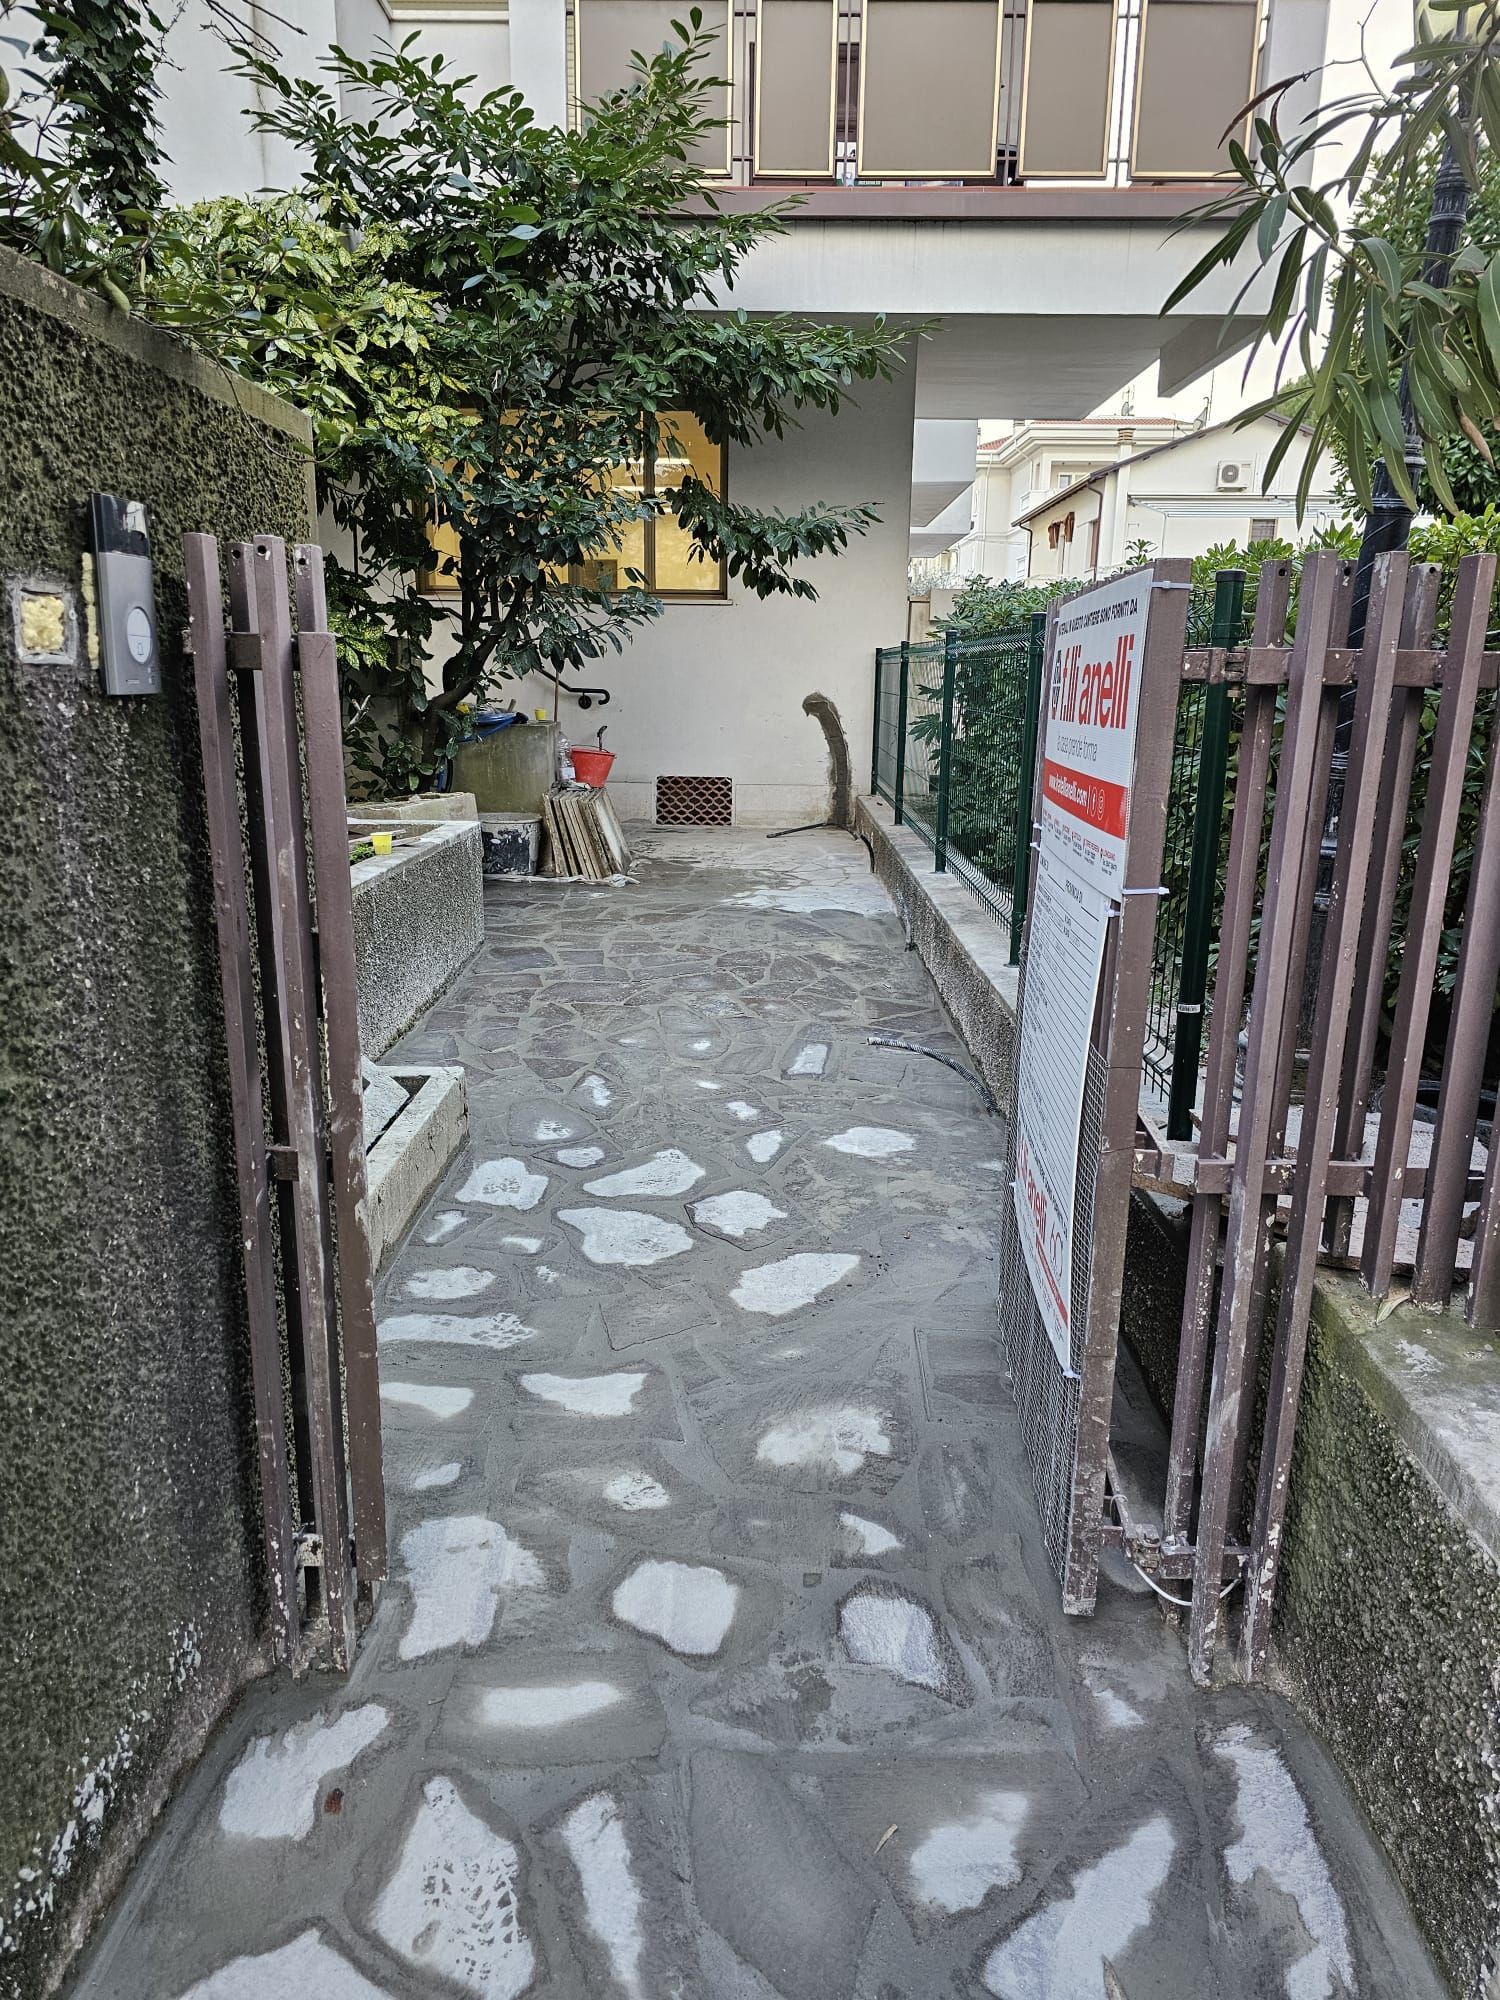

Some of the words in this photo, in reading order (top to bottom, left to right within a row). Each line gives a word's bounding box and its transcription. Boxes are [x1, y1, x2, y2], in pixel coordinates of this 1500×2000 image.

[1100, 605, 1111, 624] SONO
[1111, 600, 1129, 621] FORNITI
[1129, 597, 1138, 615] DA
[1078, 633, 1135, 729] anelli
